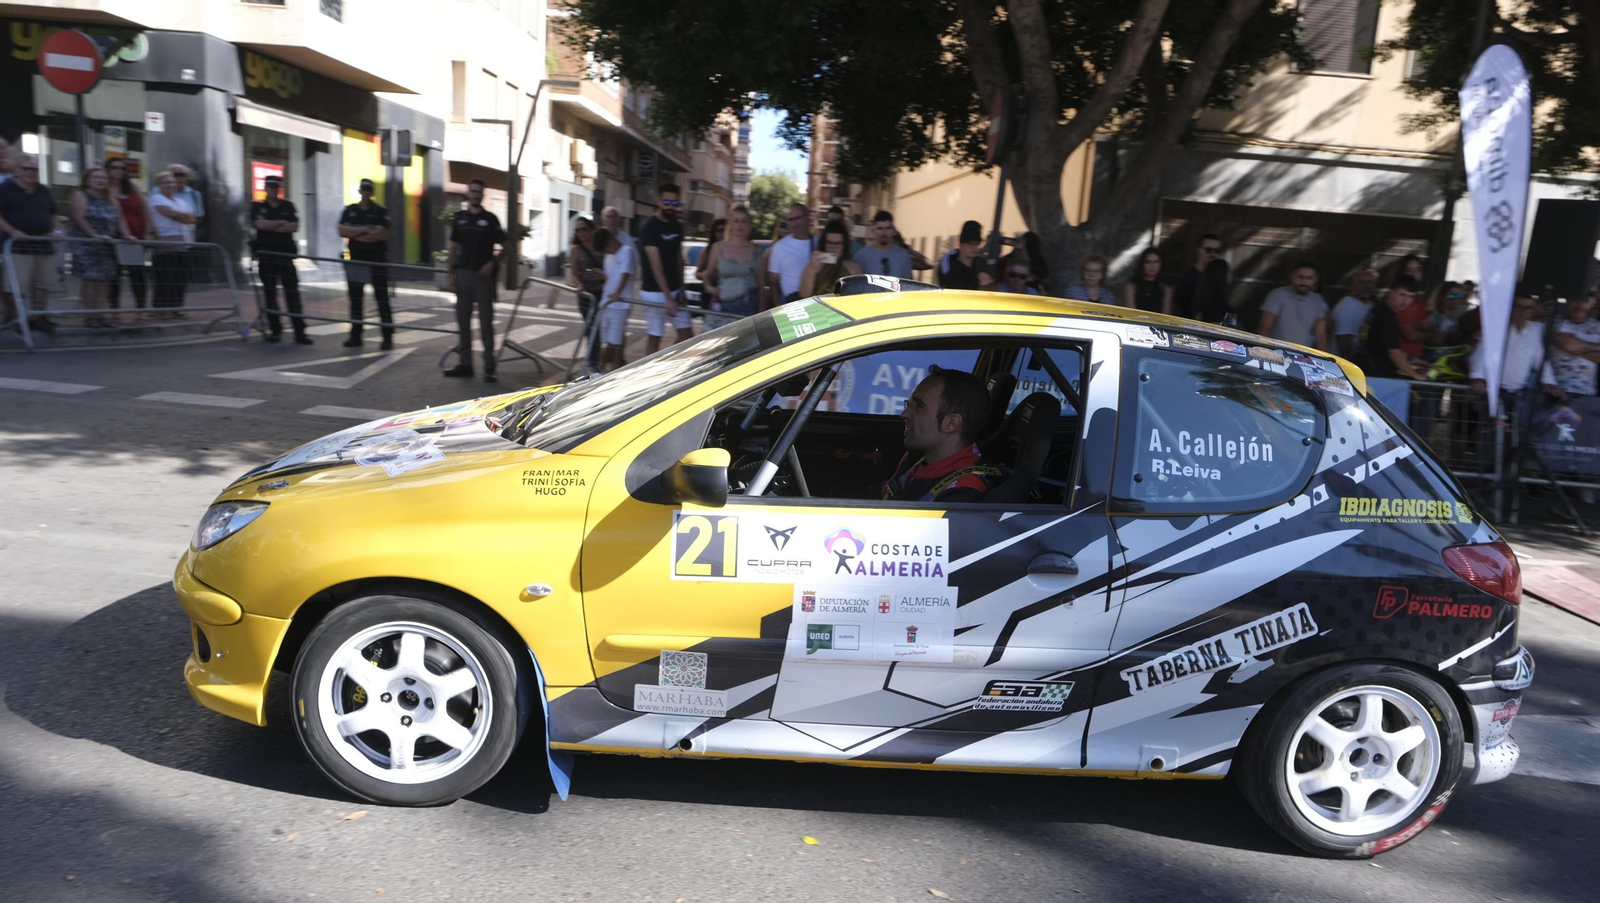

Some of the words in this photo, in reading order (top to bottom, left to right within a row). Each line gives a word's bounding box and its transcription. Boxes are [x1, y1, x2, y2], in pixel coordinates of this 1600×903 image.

[1149, 428, 1170, 452] A.
[1178, 430, 1272, 464] Callejón
[1152, 459, 1221, 480] R.Leiva
[522, 478, 548, 486] TRINI
[554, 477, 586, 486] SOFÍA
[535, 487, 566, 496] HUGO
[1339, 497, 1452, 518] IBDIAGNOSIS
[676, 515, 738, 576] 21
[871, 544, 920, 556] COSTA
[924, 545, 942, 556] DE
[747, 559, 812, 568] CUPRA
[854, 558, 944, 578] ALMERÍA
[820, 598, 870, 606] DIPUTACIÓN
[900, 596, 950, 606] ALMERÍA
[1411, 594, 1453, 602] Ferretería
[1408, 602, 1492, 618] PALMERO
[810, 632, 830, 640] UNED
[1127, 638, 1233, 690] TABERNA
[1234, 608, 1315, 655] TINAJA
[638, 690, 724, 707] MARHABA
[1024, 698, 1064, 706] andaluza
[636, 704, 725, 716] www.rmarhaba.com
